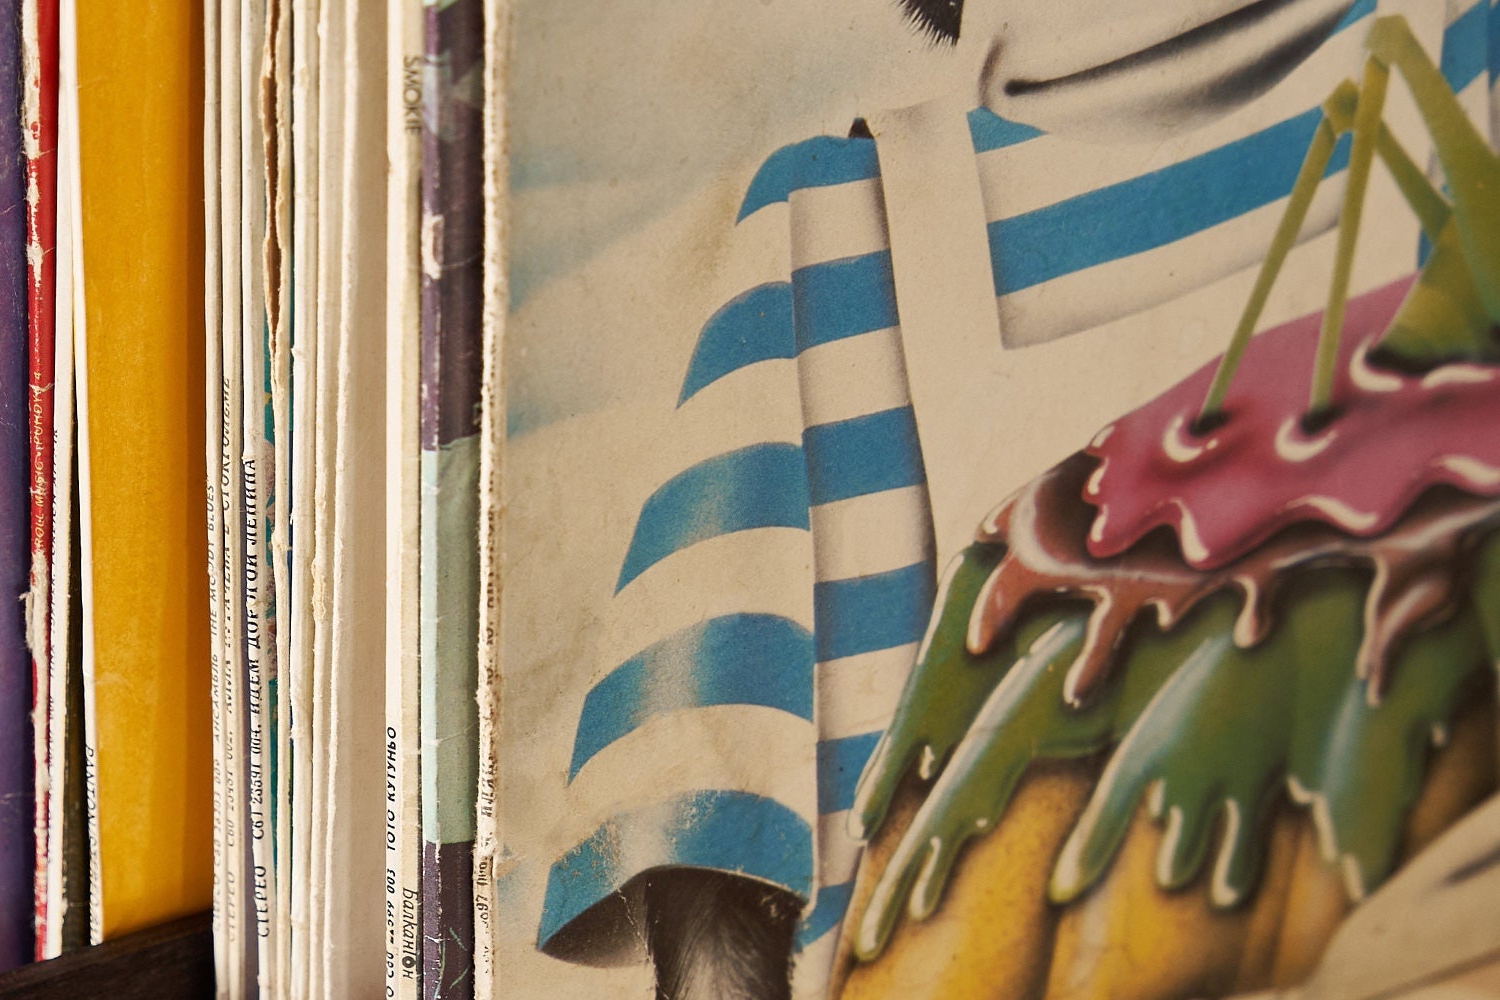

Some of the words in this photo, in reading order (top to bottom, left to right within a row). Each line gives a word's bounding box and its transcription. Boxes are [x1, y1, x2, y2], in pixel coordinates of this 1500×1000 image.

[33, 385, 44, 446] PUHDY
[33, 511, 45, 548] ROLL
[244, 459, 257, 546] ЛЕНИНА
[386, 726, 397, 802] КУТУНЬО
[253, 866, 269, 938] СТЕРЕО
[386, 868, 396, 894] 003
